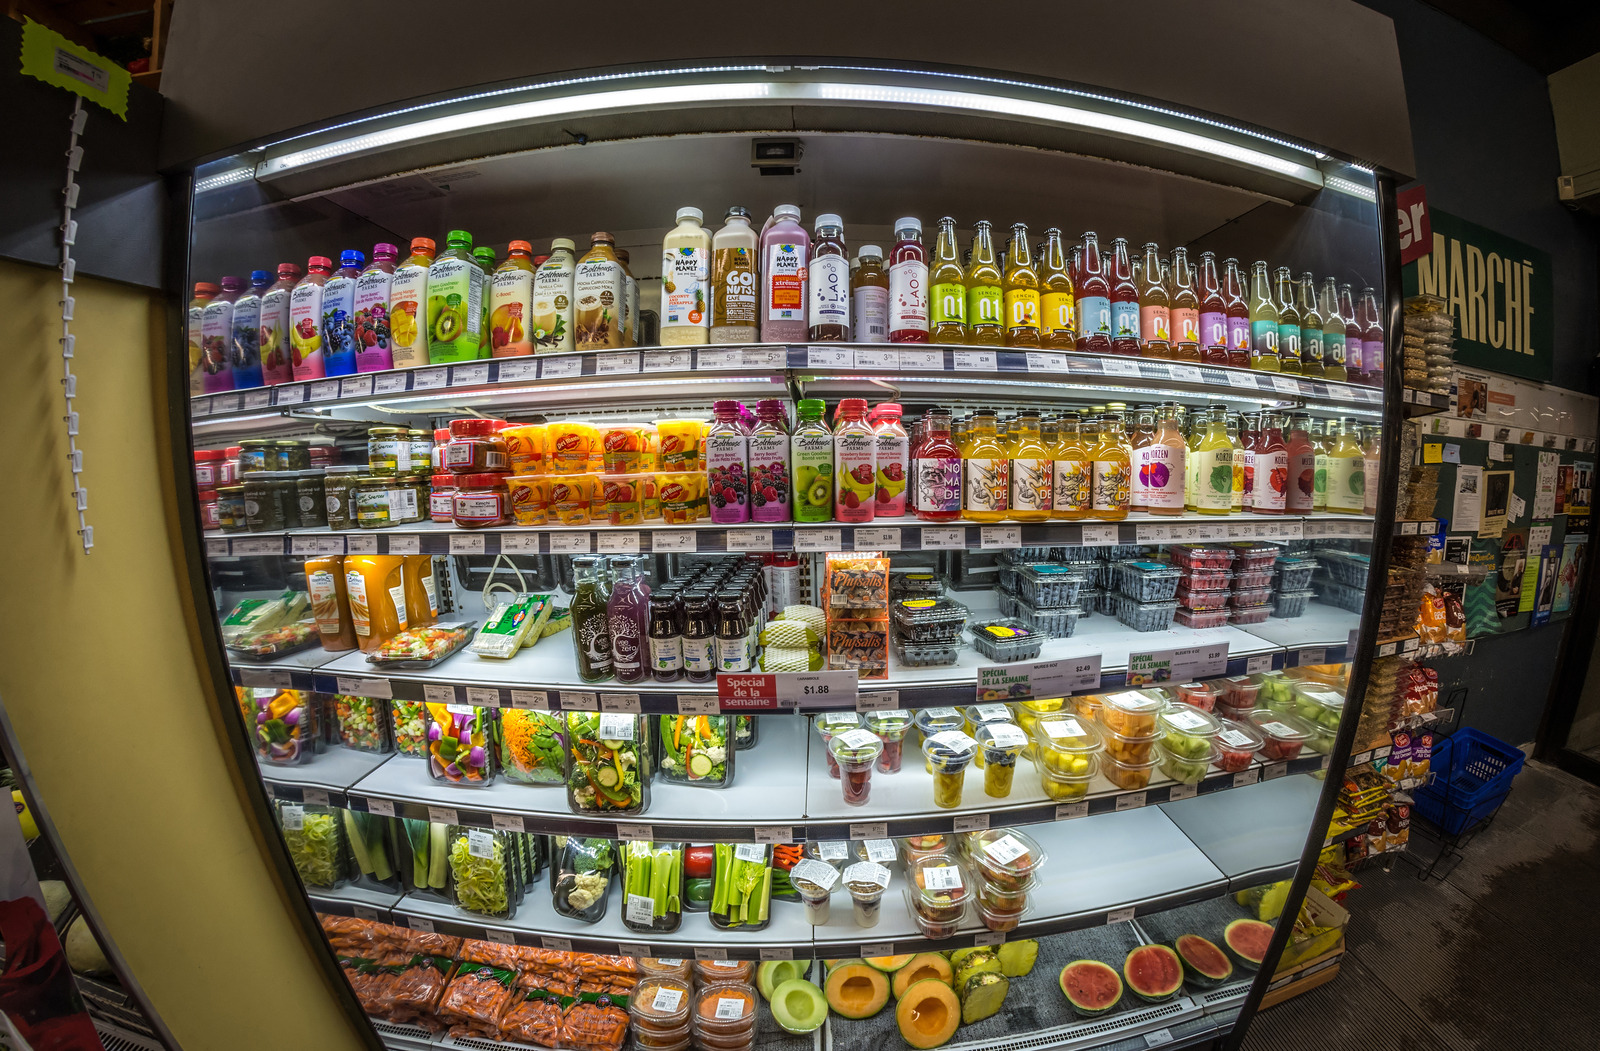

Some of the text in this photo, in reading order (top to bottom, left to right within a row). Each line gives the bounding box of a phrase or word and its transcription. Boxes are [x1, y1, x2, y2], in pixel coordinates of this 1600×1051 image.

[430, 263, 464, 276] Bolthouse
[578, 264, 615, 274] Bolthouse
[536, 271, 570, 281] Bolthouse
[357, 276, 386, 288] Bolthouse
[828, 274, 838, 301] LAO
[910, 279, 919, 307] LAO
[1418, 232, 1534, 356] MARCHÉ
[944, 295, 962, 319] 01
[980, 297, 999, 321] 01
[1014, 301, 1036, 323] 02
[1119, 313, 1138, 334] 03
[1234, 328, 1249, 347] 05
[565, 435, 580, 445] Monte
[612, 433, 625, 443] Monte
[668, 436, 678, 446] Monte
[707, 438, 740, 448] Bolthouse
[750, 438, 783, 447] Bolthouse
[795, 438, 831, 447] Bolthouse
[838, 438, 872, 447] Bolthouse
[944, 464, 960, 474] NO
[944, 478, 960, 486] MA
[519, 487, 530, 496] Monte
[609, 484, 618, 493] Monte
[668, 485, 682, 493] Monte
[944, 490, 960, 500] DE
[835, 573, 882, 590] Physalis
[833, 634, 881, 652] Physalis
[1132, 654, 1153, 663] SPÉCIAL
[1147, 660, 1170, 669] SEMAINE
[982, 668, 1007, 677] SPÉCIAL
[727, 678, 765, 689] Spécial
[1001, 675, 1029, 684] SEMAINE
[734, 688, 748, 697] de
[804, 686, 829, 695] $1.88
[725, 697, 770, 706] semaine
